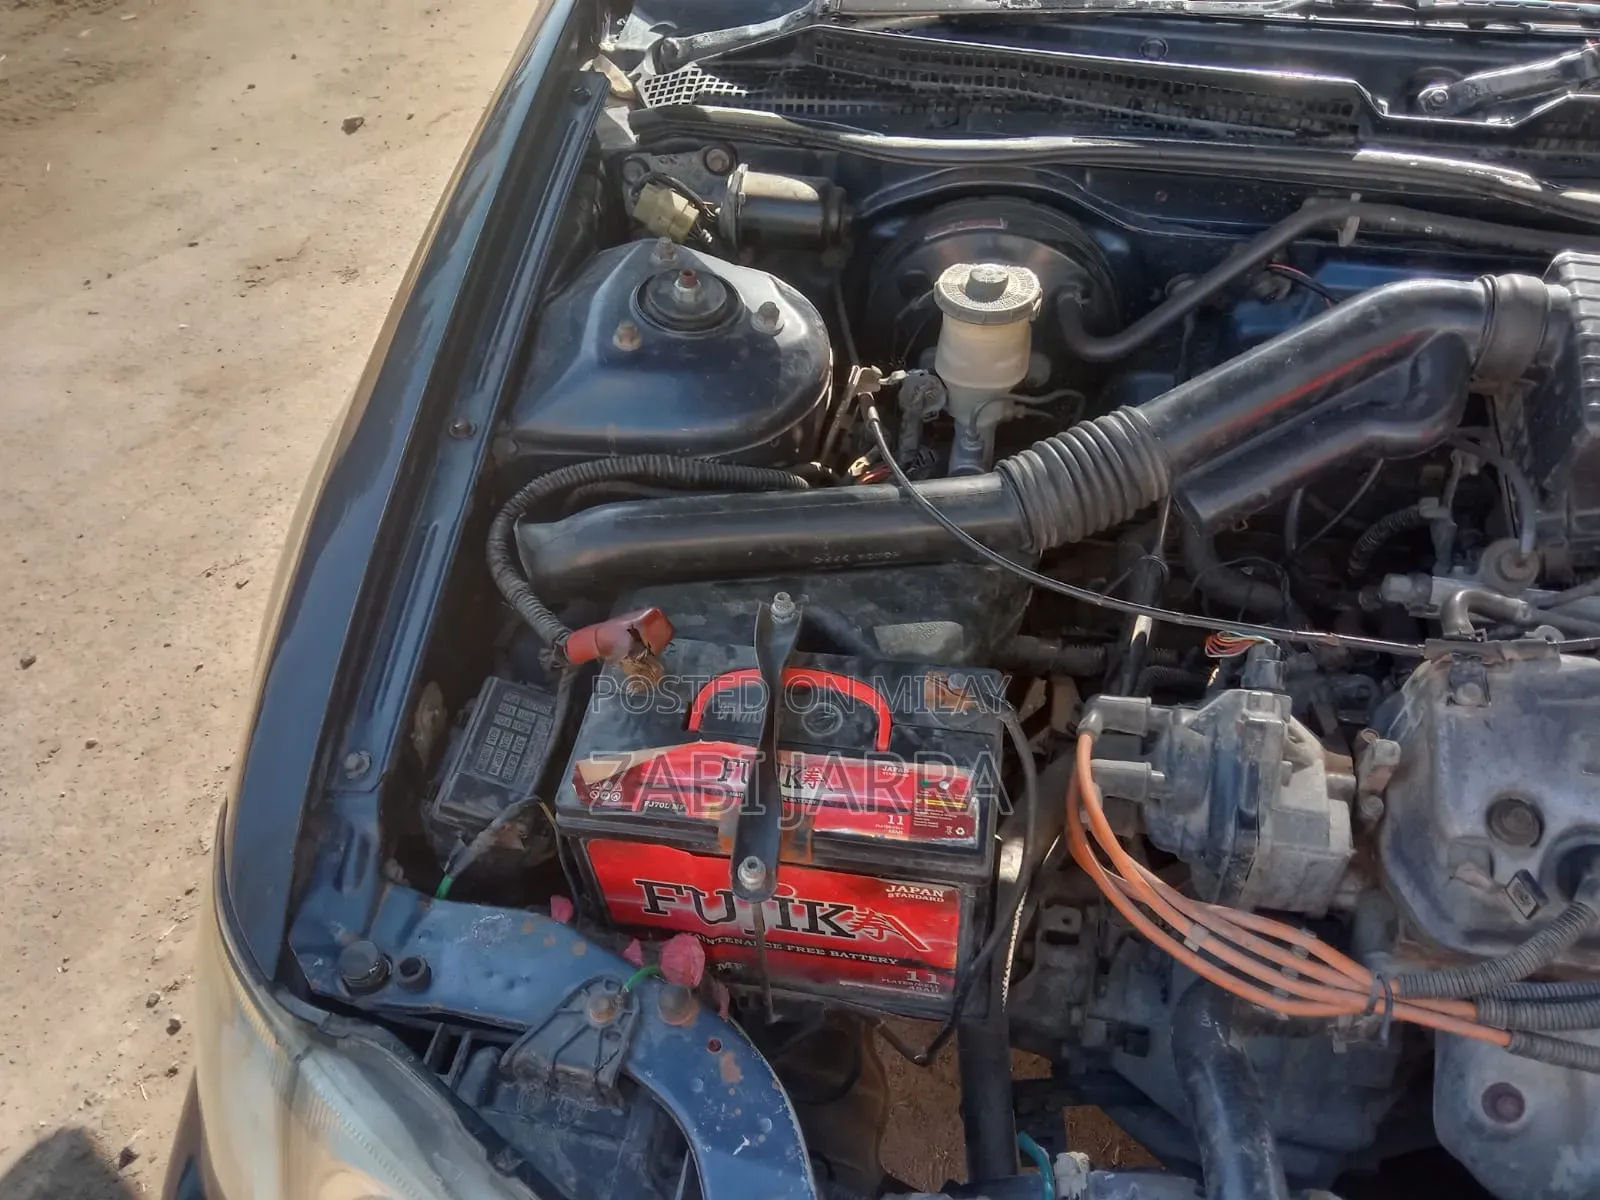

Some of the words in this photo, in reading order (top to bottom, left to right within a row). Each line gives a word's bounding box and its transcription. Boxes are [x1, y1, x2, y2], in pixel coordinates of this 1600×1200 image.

[882, 765, 910, 774] JAPAN
[888, 814, 904, 825] 11
[885, 885, 945, 897] JAPAN
[887, 892, 945, 903] STANDARD
[787, 945, 825, 955] FREE
[830, 950, 899, 965] BATTERY
[907, 970, 940, 985] 11
